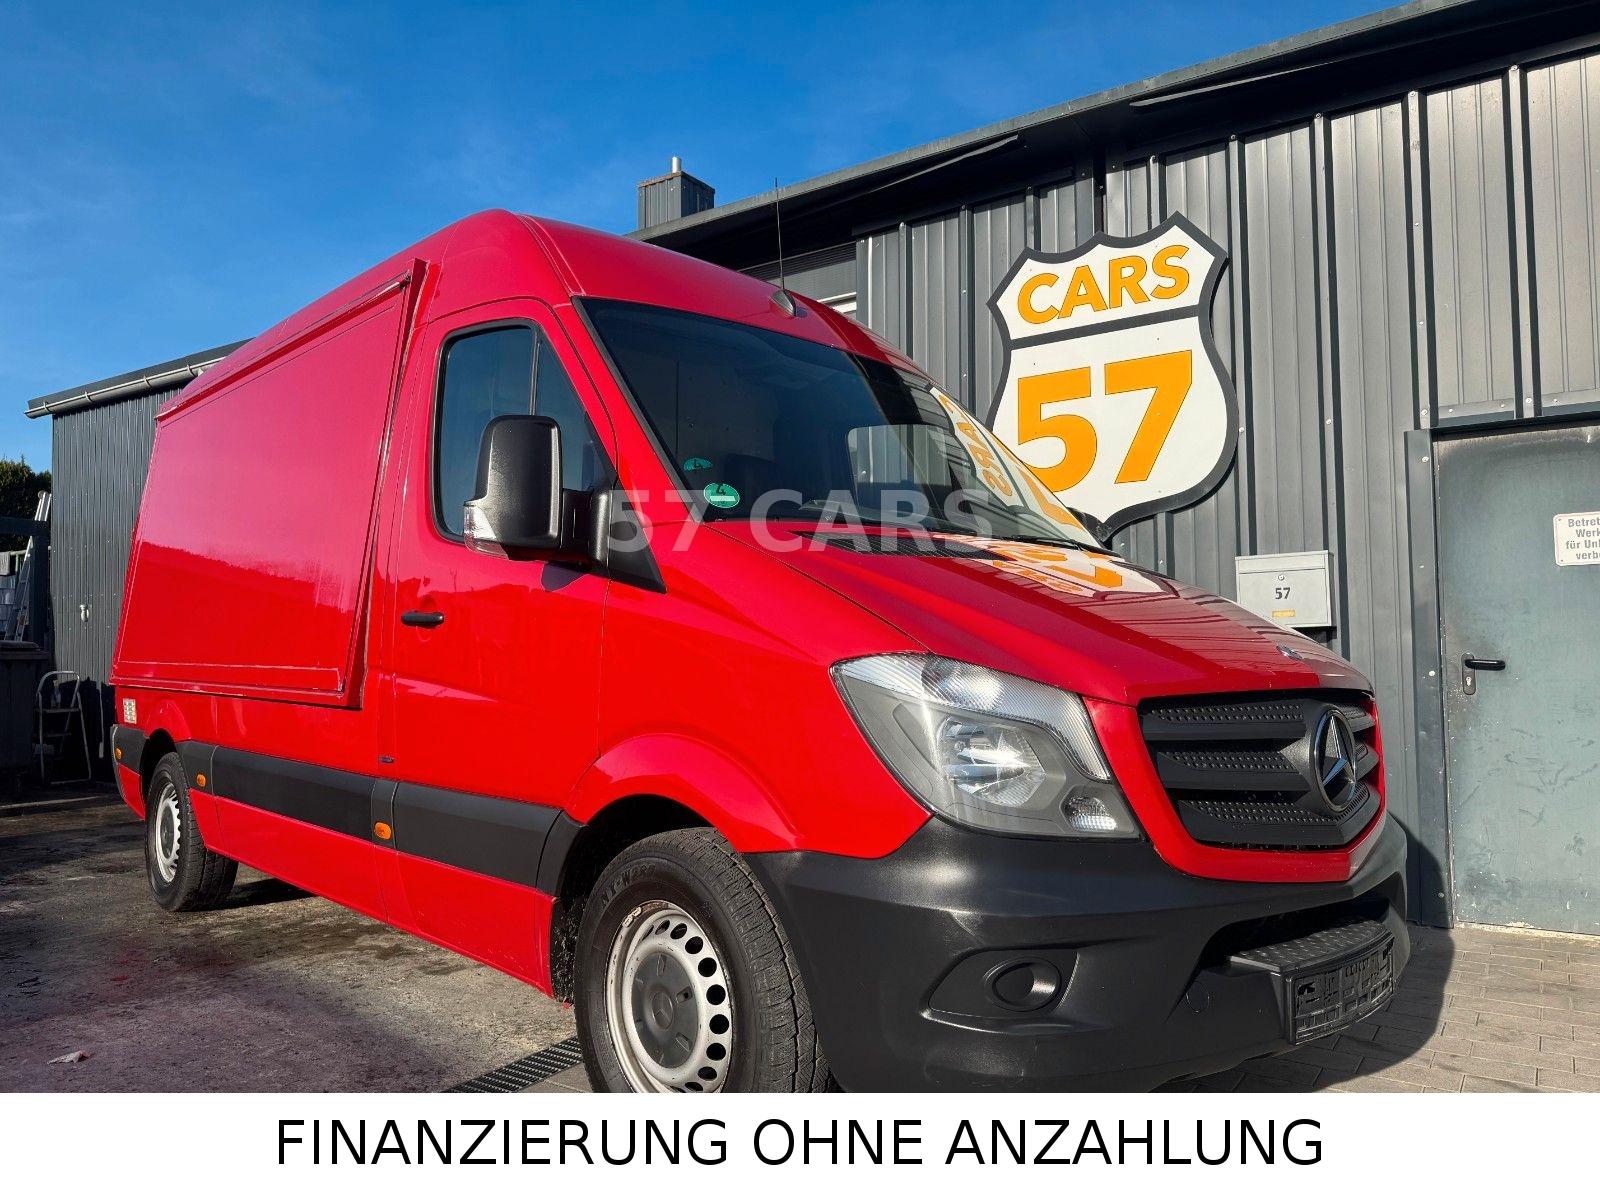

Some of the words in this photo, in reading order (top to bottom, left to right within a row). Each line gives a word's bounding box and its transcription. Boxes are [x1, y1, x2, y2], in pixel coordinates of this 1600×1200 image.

[1017, 244, 1190, 325] CARS
[1018, 349, 1193, 493] 57
[1566, 540, 1581, 549] für
[1275, 587, 1290, 600] 57
